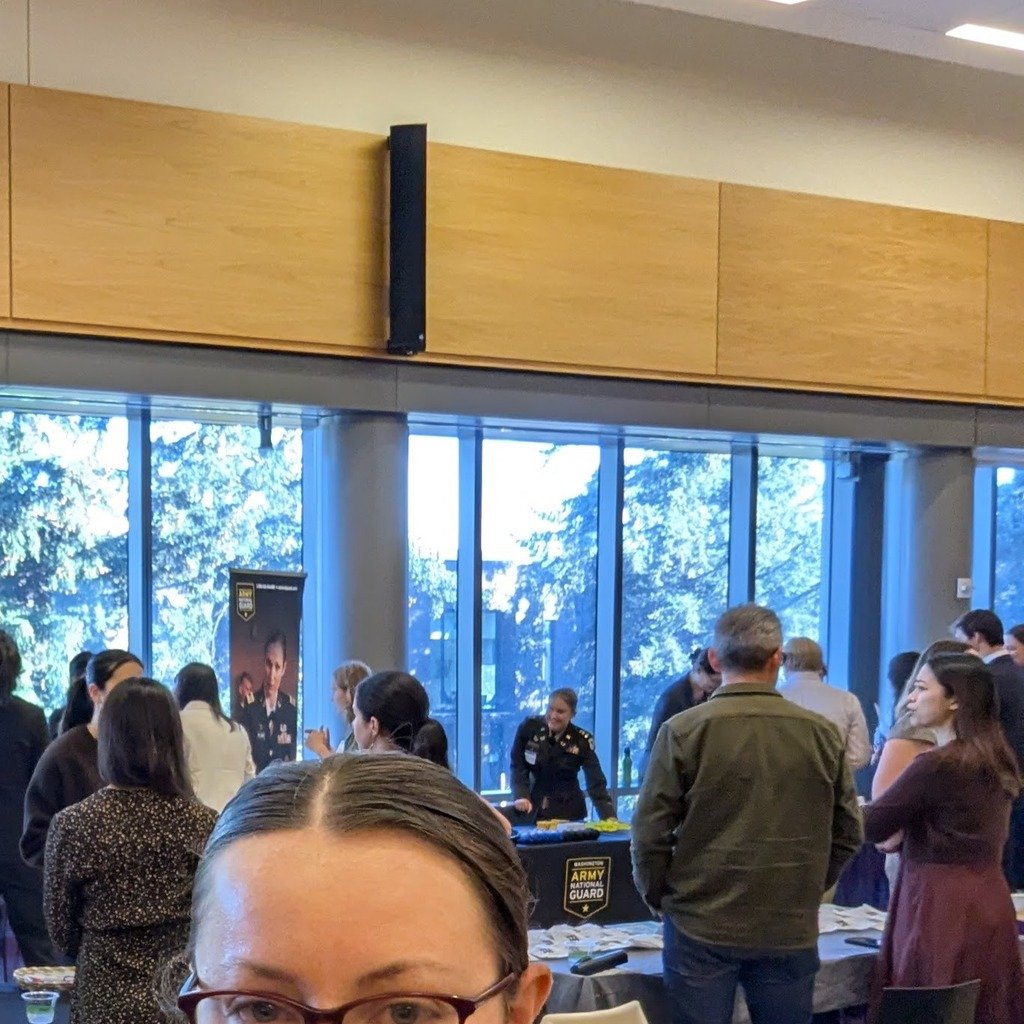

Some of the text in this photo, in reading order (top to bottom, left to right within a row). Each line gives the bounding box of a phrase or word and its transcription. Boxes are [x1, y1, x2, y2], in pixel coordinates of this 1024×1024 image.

[571, 869, 605, 882] ARMY
[570, 880, 605, 889] NATIONAL
[569, 888, 604, 900] GUARD
